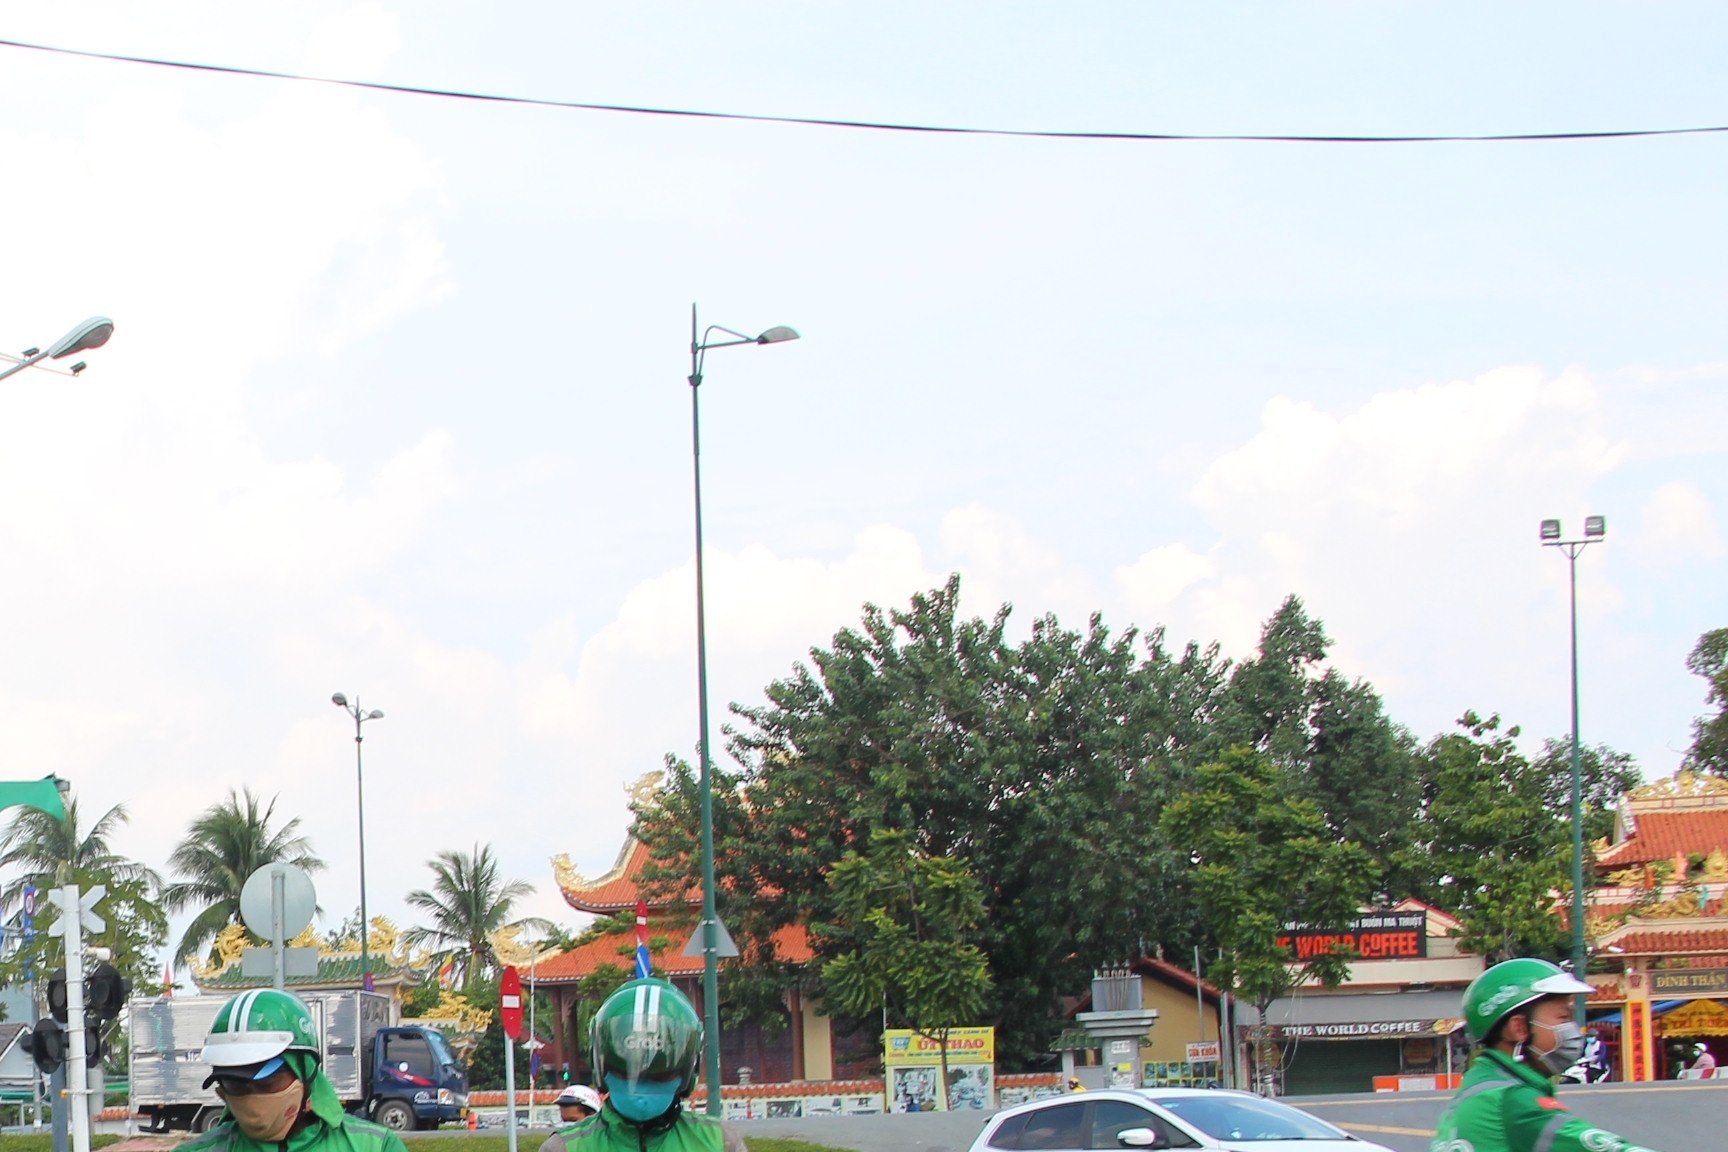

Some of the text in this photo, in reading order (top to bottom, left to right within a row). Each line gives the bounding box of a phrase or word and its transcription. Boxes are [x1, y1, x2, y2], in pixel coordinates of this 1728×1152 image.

[1384, 917, 1397, 927] MA
[1281, 1021, 1422, 1037] THE WORLD COFFEE
